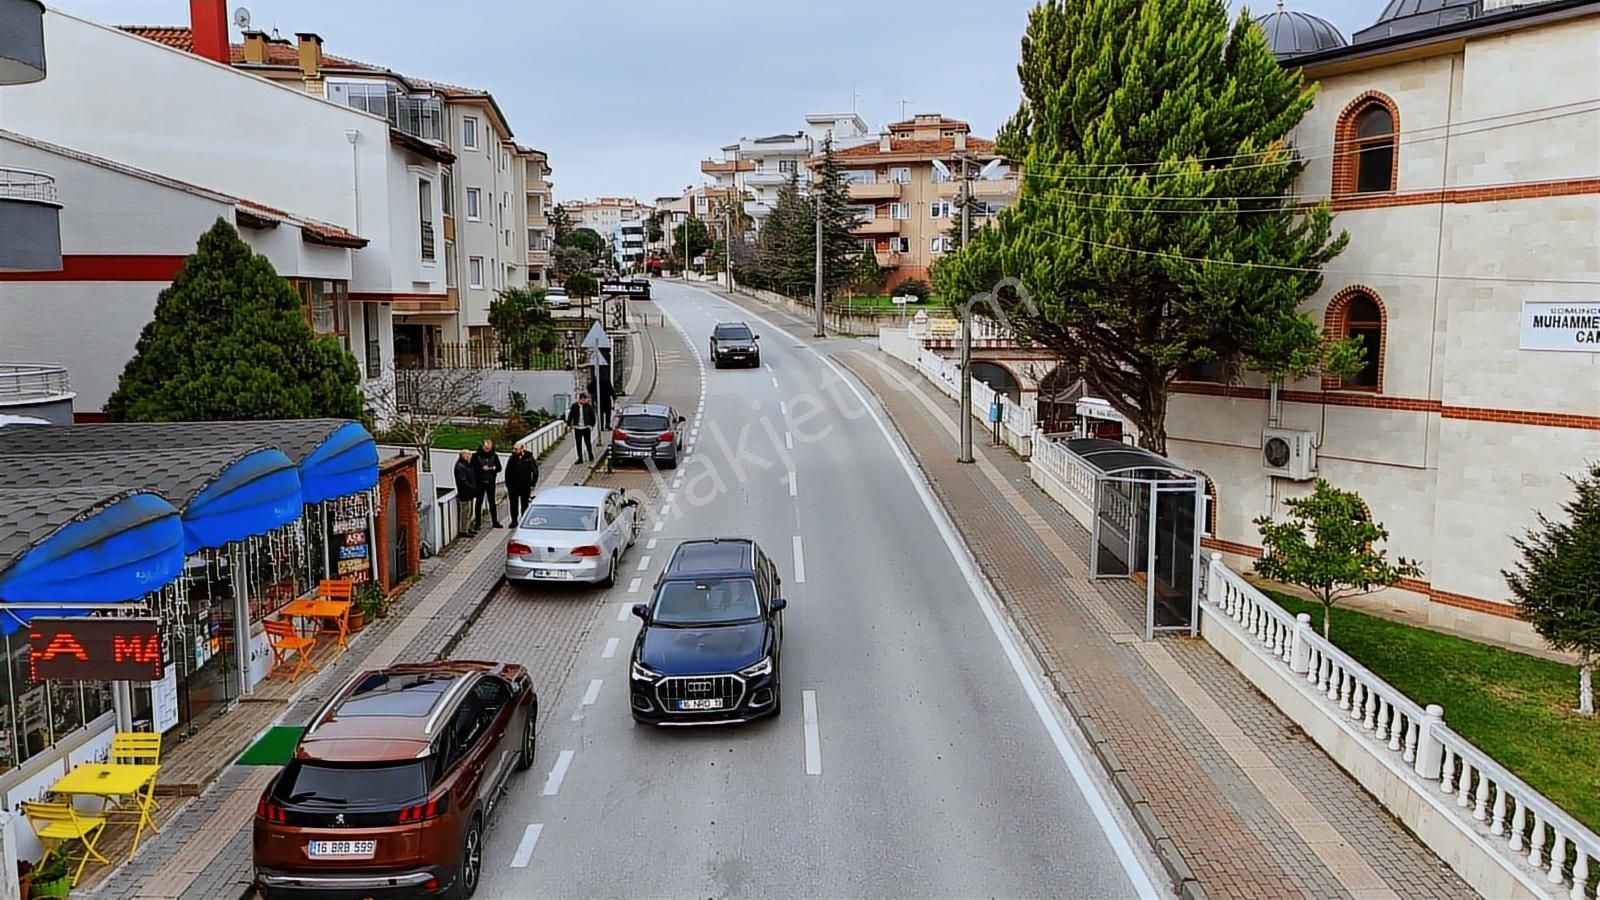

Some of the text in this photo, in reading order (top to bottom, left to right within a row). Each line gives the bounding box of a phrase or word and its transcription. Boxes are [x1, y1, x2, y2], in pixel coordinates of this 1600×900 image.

[317, 841, 373, 853] 16 BRB 599
